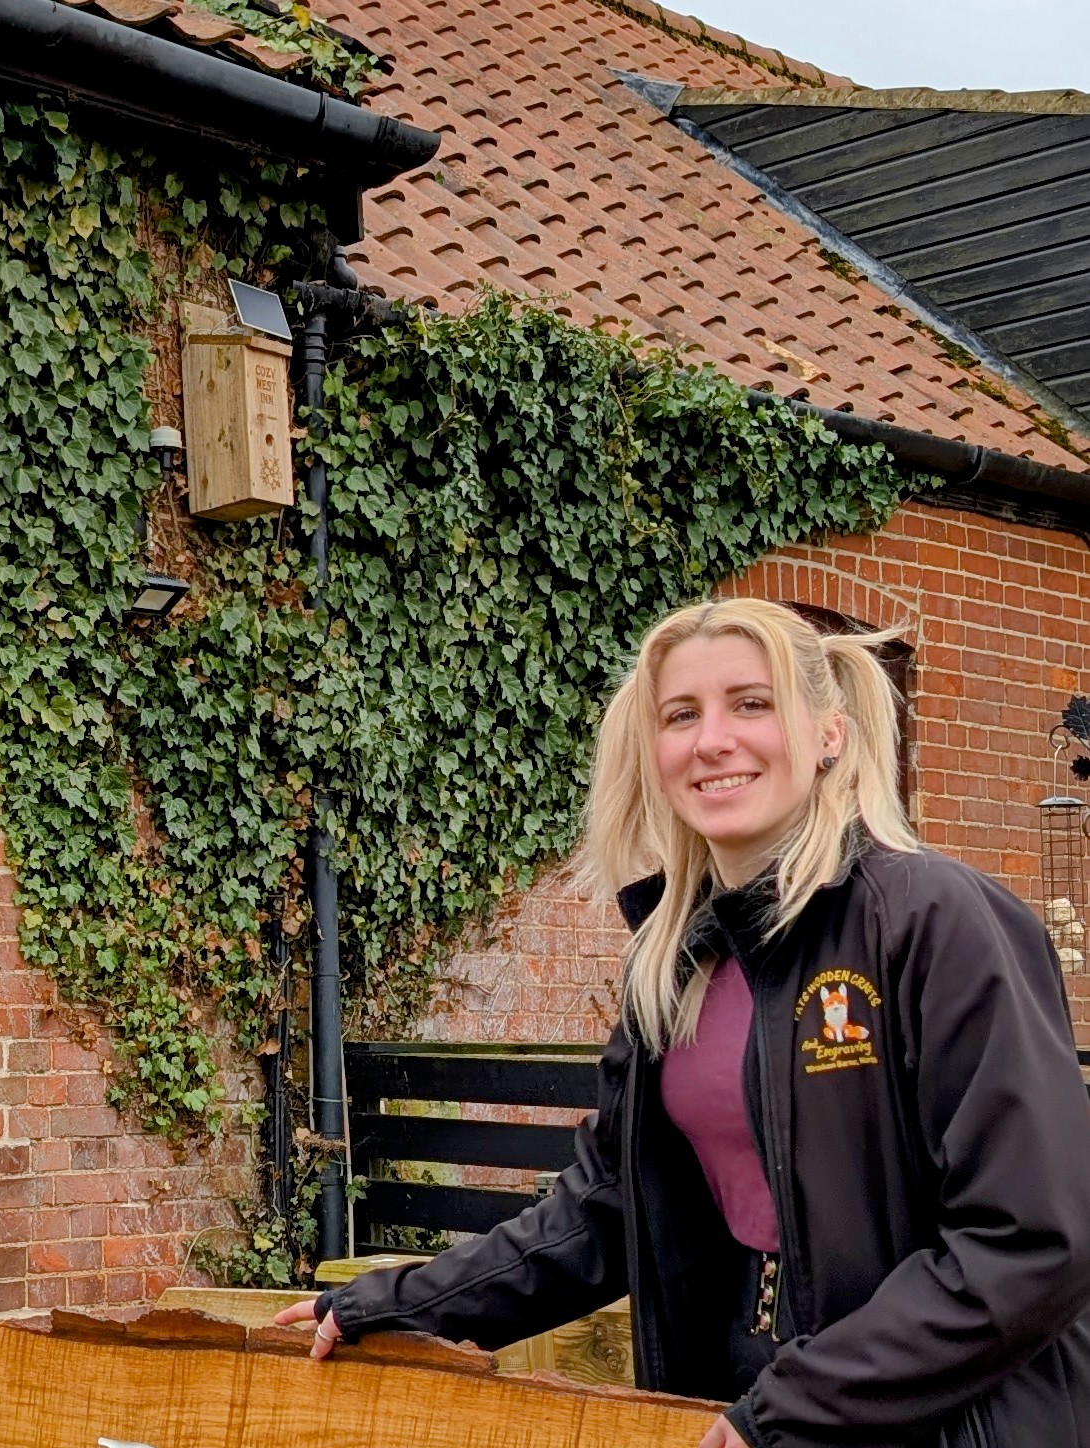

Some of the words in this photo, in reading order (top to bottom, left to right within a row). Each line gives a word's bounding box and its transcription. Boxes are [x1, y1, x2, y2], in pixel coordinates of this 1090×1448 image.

[255, 365, 276, 380] COZY
[256, 378, 276, 393] NEST
[806, 969, 851, 994] WOODEN
[849, 973, 882, 1008] CRAFTS
[816, 1041, 872, 1060] Engraving
